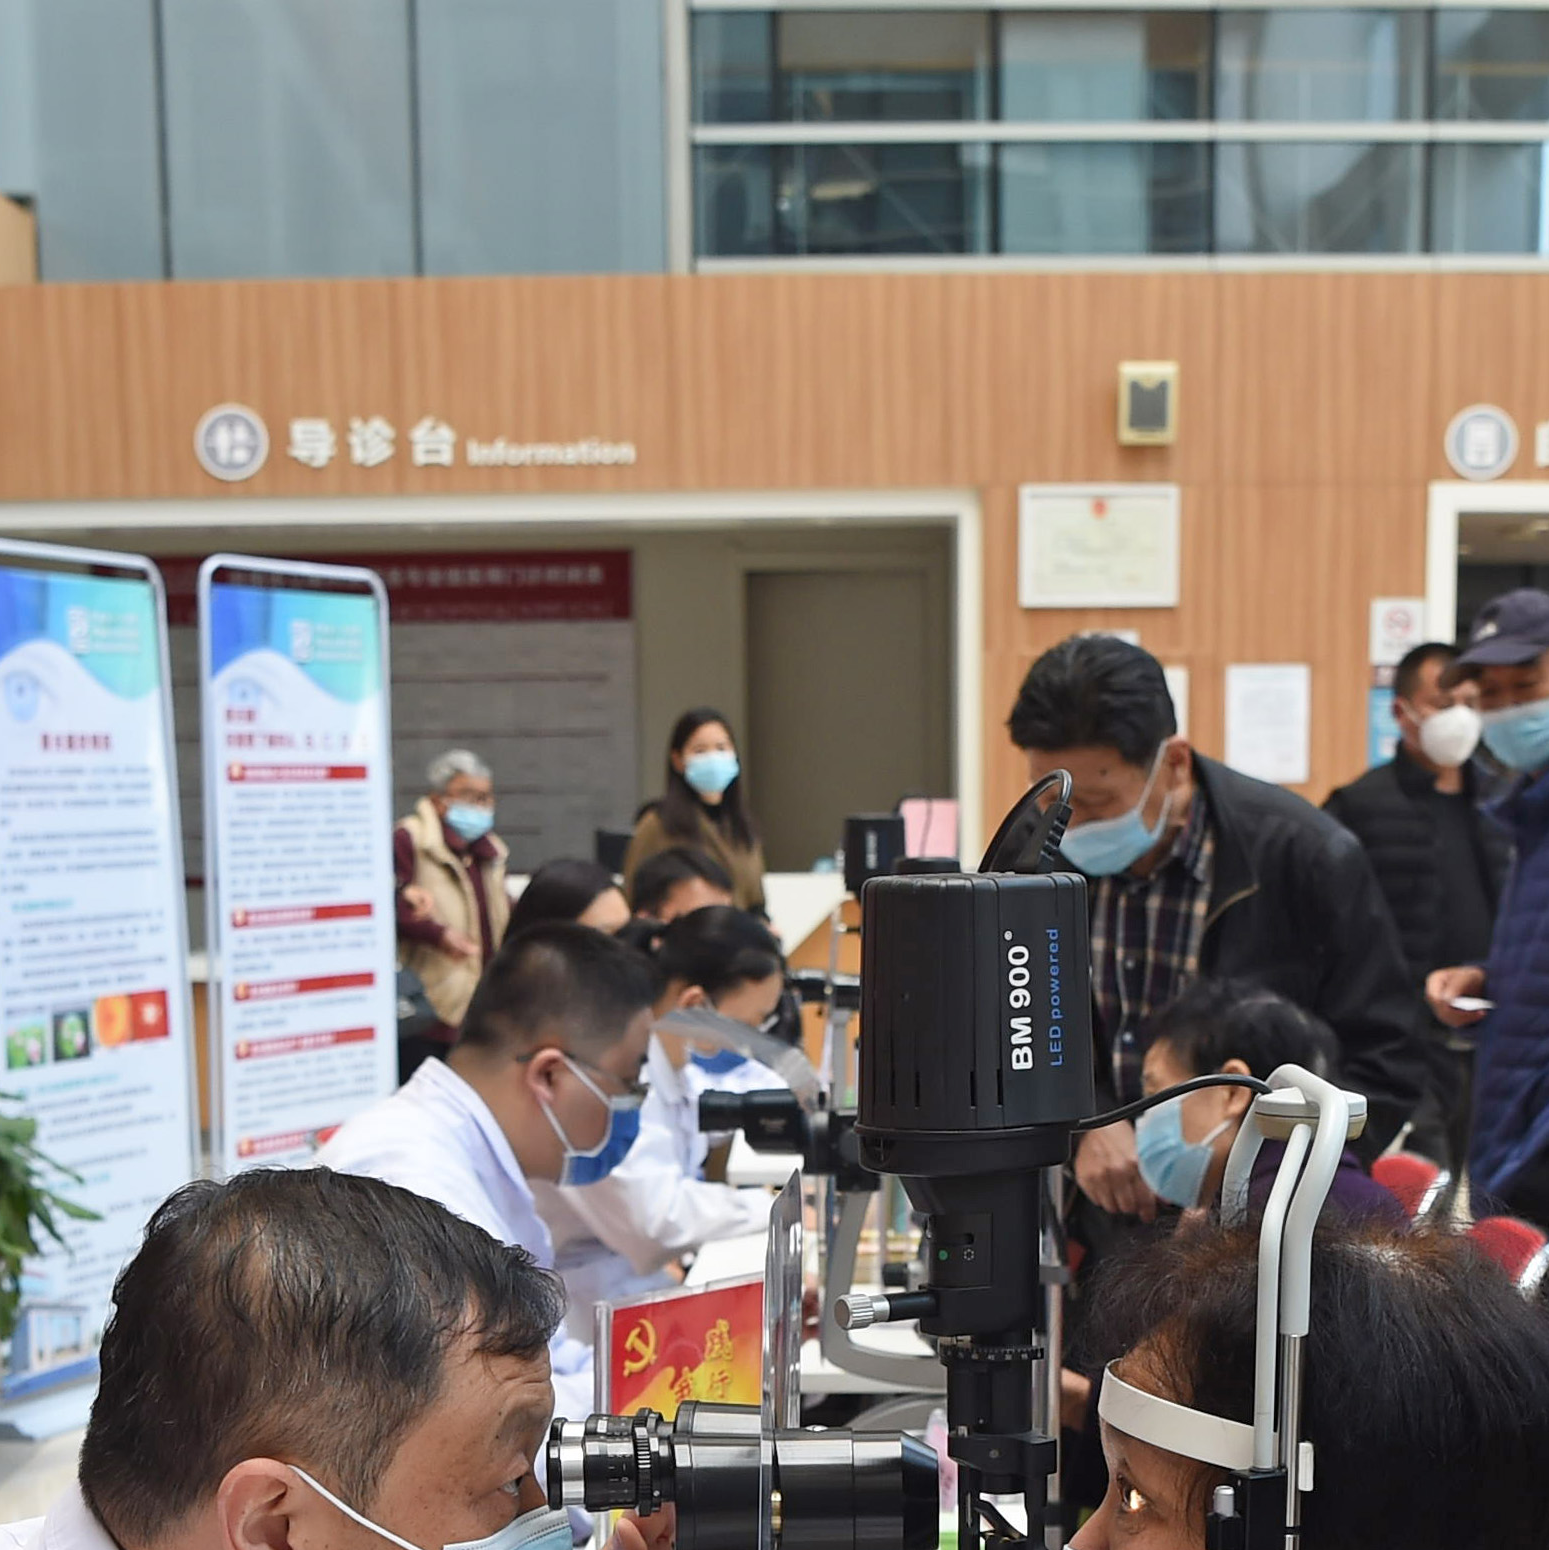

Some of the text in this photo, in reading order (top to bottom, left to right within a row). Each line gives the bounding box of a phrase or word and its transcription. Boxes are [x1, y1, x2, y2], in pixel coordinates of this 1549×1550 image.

[287, 416, 637, 468] 导诊台 Information
[1045, 928, 1064, 1067] LED powered
[1010, 1016, 1034, 1071] BM
